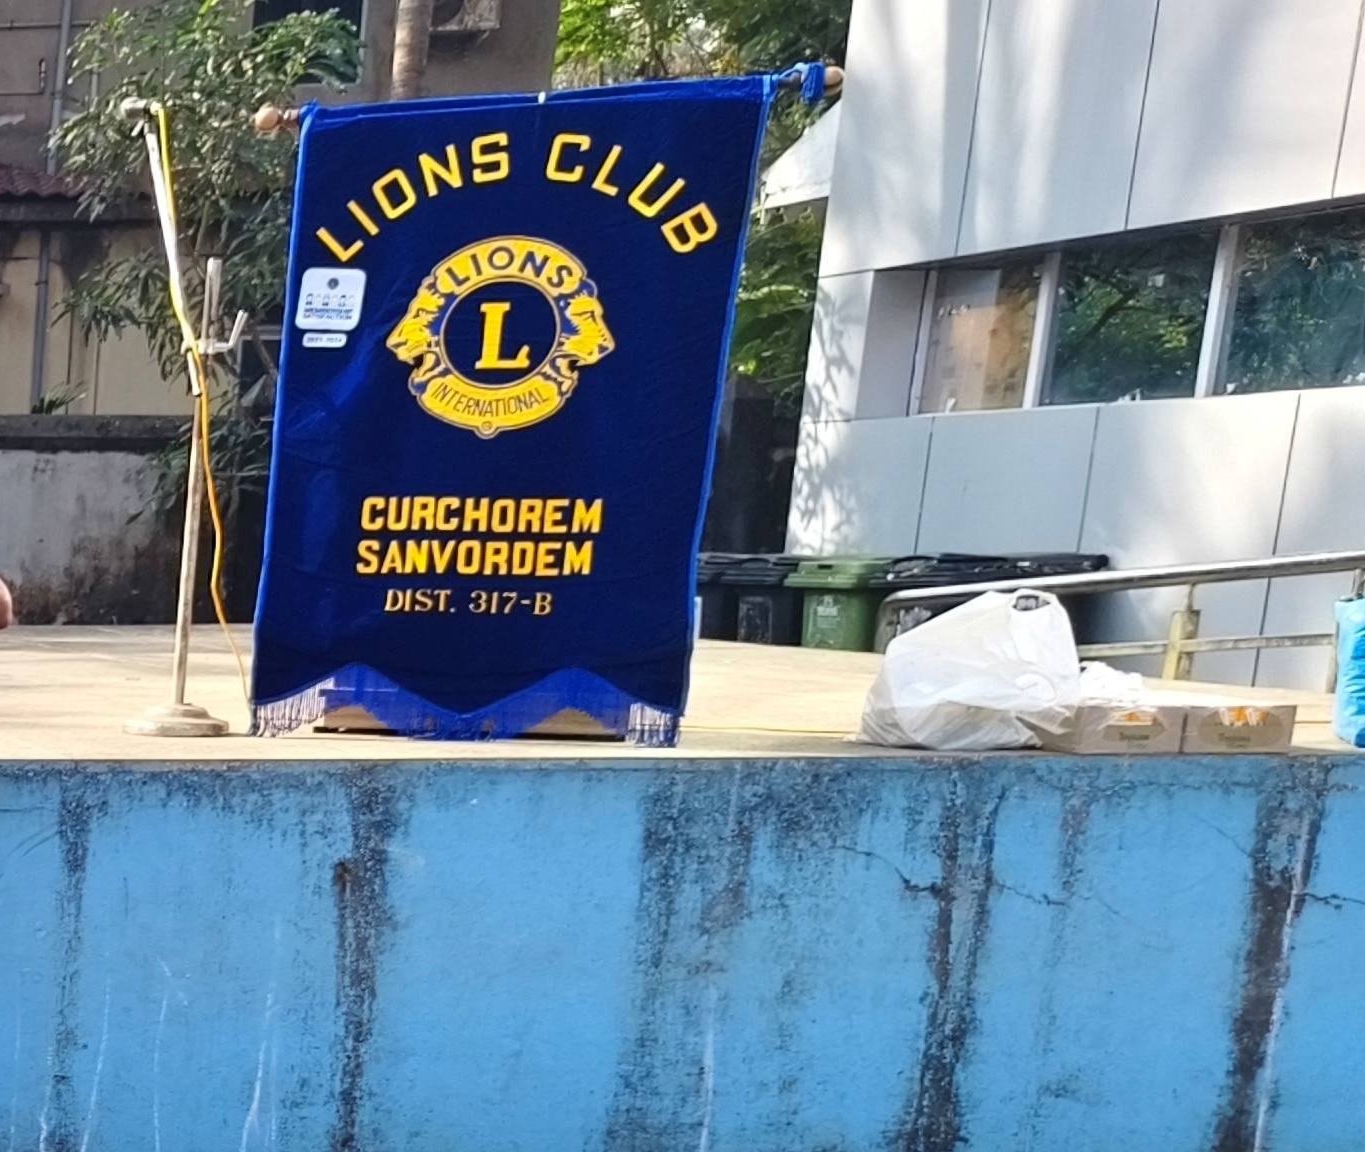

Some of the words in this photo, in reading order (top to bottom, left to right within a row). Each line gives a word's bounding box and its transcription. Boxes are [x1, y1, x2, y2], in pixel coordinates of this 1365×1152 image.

[316, 132, 509, 262] LIONS
[546, 133, 718, 254] CLUB
[446, 246, 572, 289] LIONS
[475, 302, 531, 370] L
[430, 382, 550, 417] INTERNATIONAL
[360, 496, 604, 534] CURCHOREM
[356, 539, 594, 576] SANVORDEM
[384, 589, 456, 613] DIST.
[468, 590, 553, 615] 317-B
